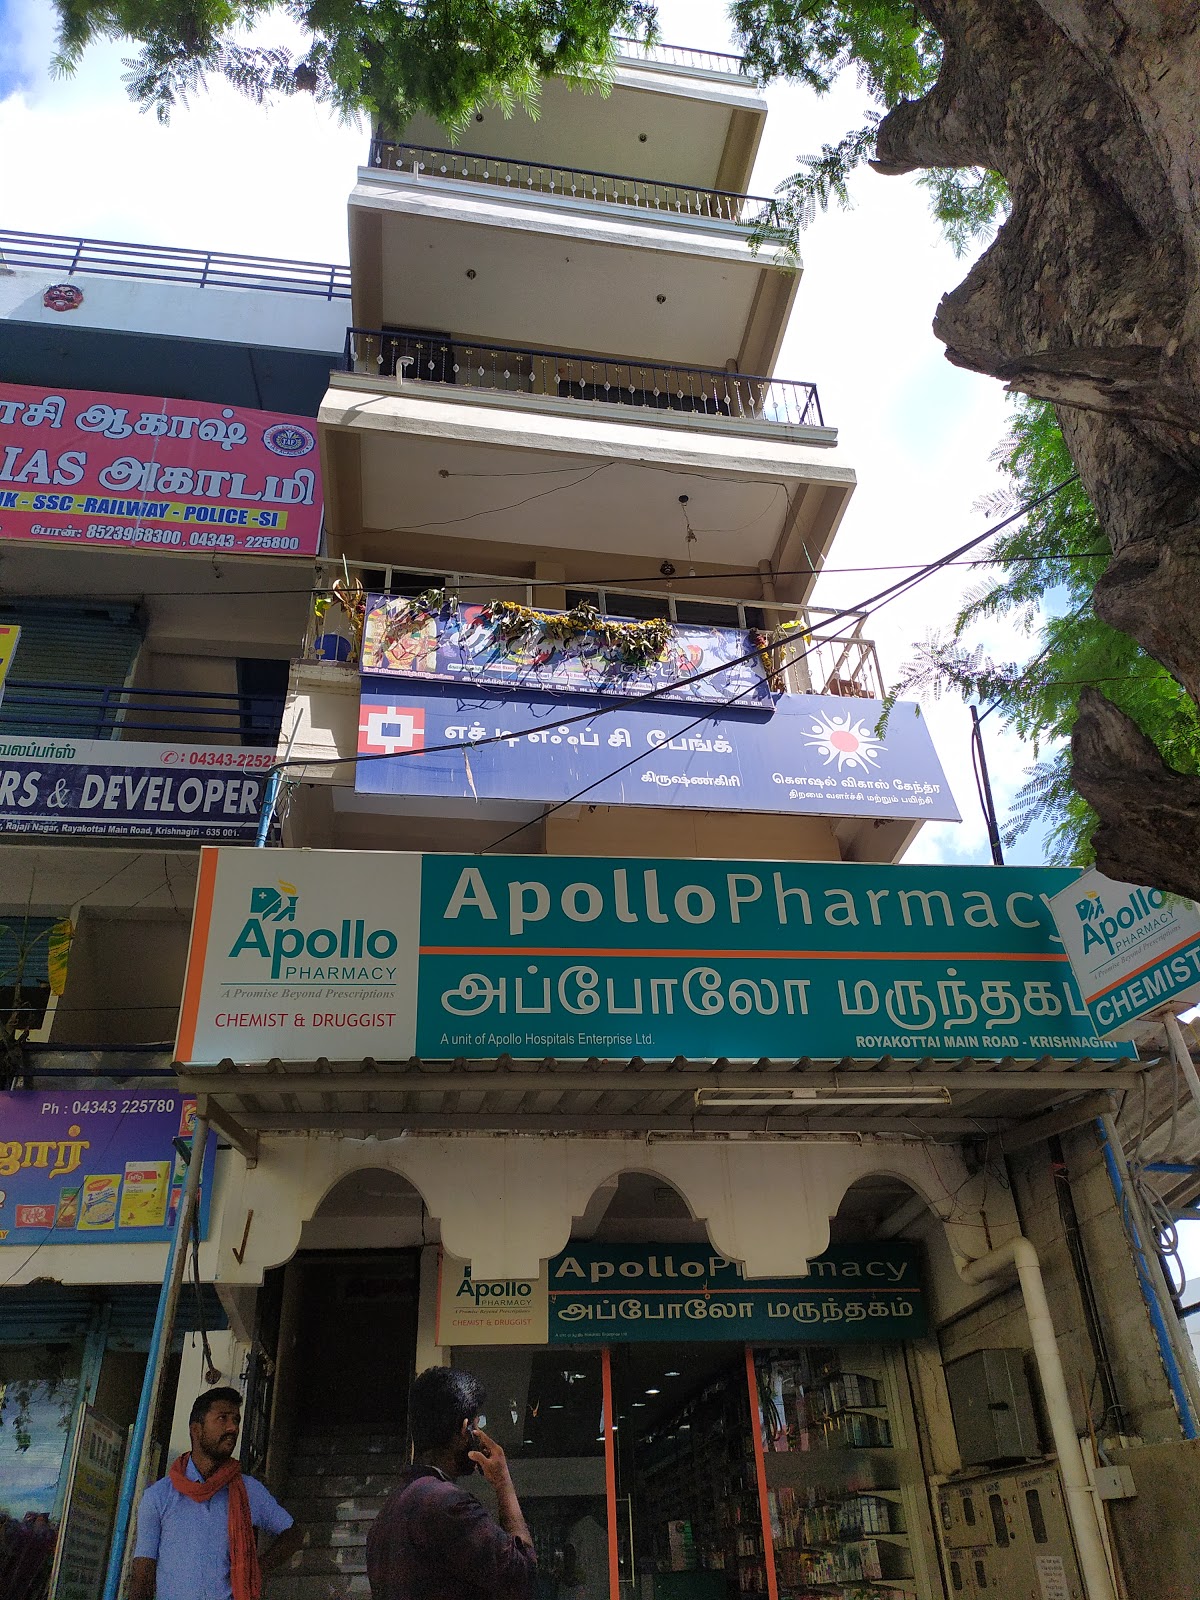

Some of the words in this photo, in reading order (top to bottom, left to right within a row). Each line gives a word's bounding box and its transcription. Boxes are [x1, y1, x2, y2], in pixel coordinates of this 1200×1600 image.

[75, 403, 248, 450] ஆகாஷ்
[0, 446, 87, 486] IAS
[99, 456, 316, 505] அகாடமி
[32, 494, 74, 511] SSC
[183, 506, 248, 525] POLICE
[189, 532, 235, 548] 04343
[245, 535, 299, 550] 225800
[646, 729, 733, 753] பேங்க்
[641, 771, 740, 787] கிருஷ்ணகிரி
[841, 776, 890, 790] விகாஸ்
[0, 771, 42, 807] RS
[47, 778, 71, 809] &
[789, 789, 823, 800] திறமை
[866, 794, 899, 804] மற்றும்
[6, 822, 30, 832] Rajaji
[32, 823, 59, 833] Nagar,
[61, 824, 106, 834] Rayakottai
[108, 825, 128, 834] Main
[130, 826, 153, 835] Road,
[155, 827, 199, 836] Krishnagiri
[206, 828, 220, 836] 635
[1115, 909, 1174, 951] PHARMACY
[228, 919, 398, 979] Apollo
[285, 967, 397, 980] PHARMACY
[221, 989, 230, 998] A
[232, 989, 278, 999] Promise
[281, 989, 321, 1000] Beyond
[325, 989, 395, 1000] Prescriptions
[441, 965, 810, 1016] அப்போலோ
[1095, 946, 1200, 1026] CHEMIST
[215, 1013, 288, 1027] CHEMIST
[294, 1014, 305, 1027] &
[312, 1013, 396, 1027] DRUGGIST
[440, 1034, 449, 1045] A
[451, 1033, 472, 1045] unit
[474, 1033, 486, 1045] of
[487, 1033, 522, 1047] Apollo
[525, 1033, 575, 1047] Hospitals
[578, 1033, 632, 1047] Enterprise
[636, 1033, 655, 1045] Ltd.
[856, 1036, 940, 1048] ROYAKOTTAI
[944, 1036, 979, 1048] MAIN
[982, 1036, 1019, 1048] ROAD
[42, 1103, 59, 1114] Ph
[72, 1101, 117, 1114] 04343
[120, 1099, 175, 1113] 225780
[456, 1280, 532, 1305] Apollo
[557, 1299, 754, 1321] அப்போலோ
[767, 1297, 914, 1323] மருந்தகம்
[452, 1319, 484, 1327] CHEMIST
